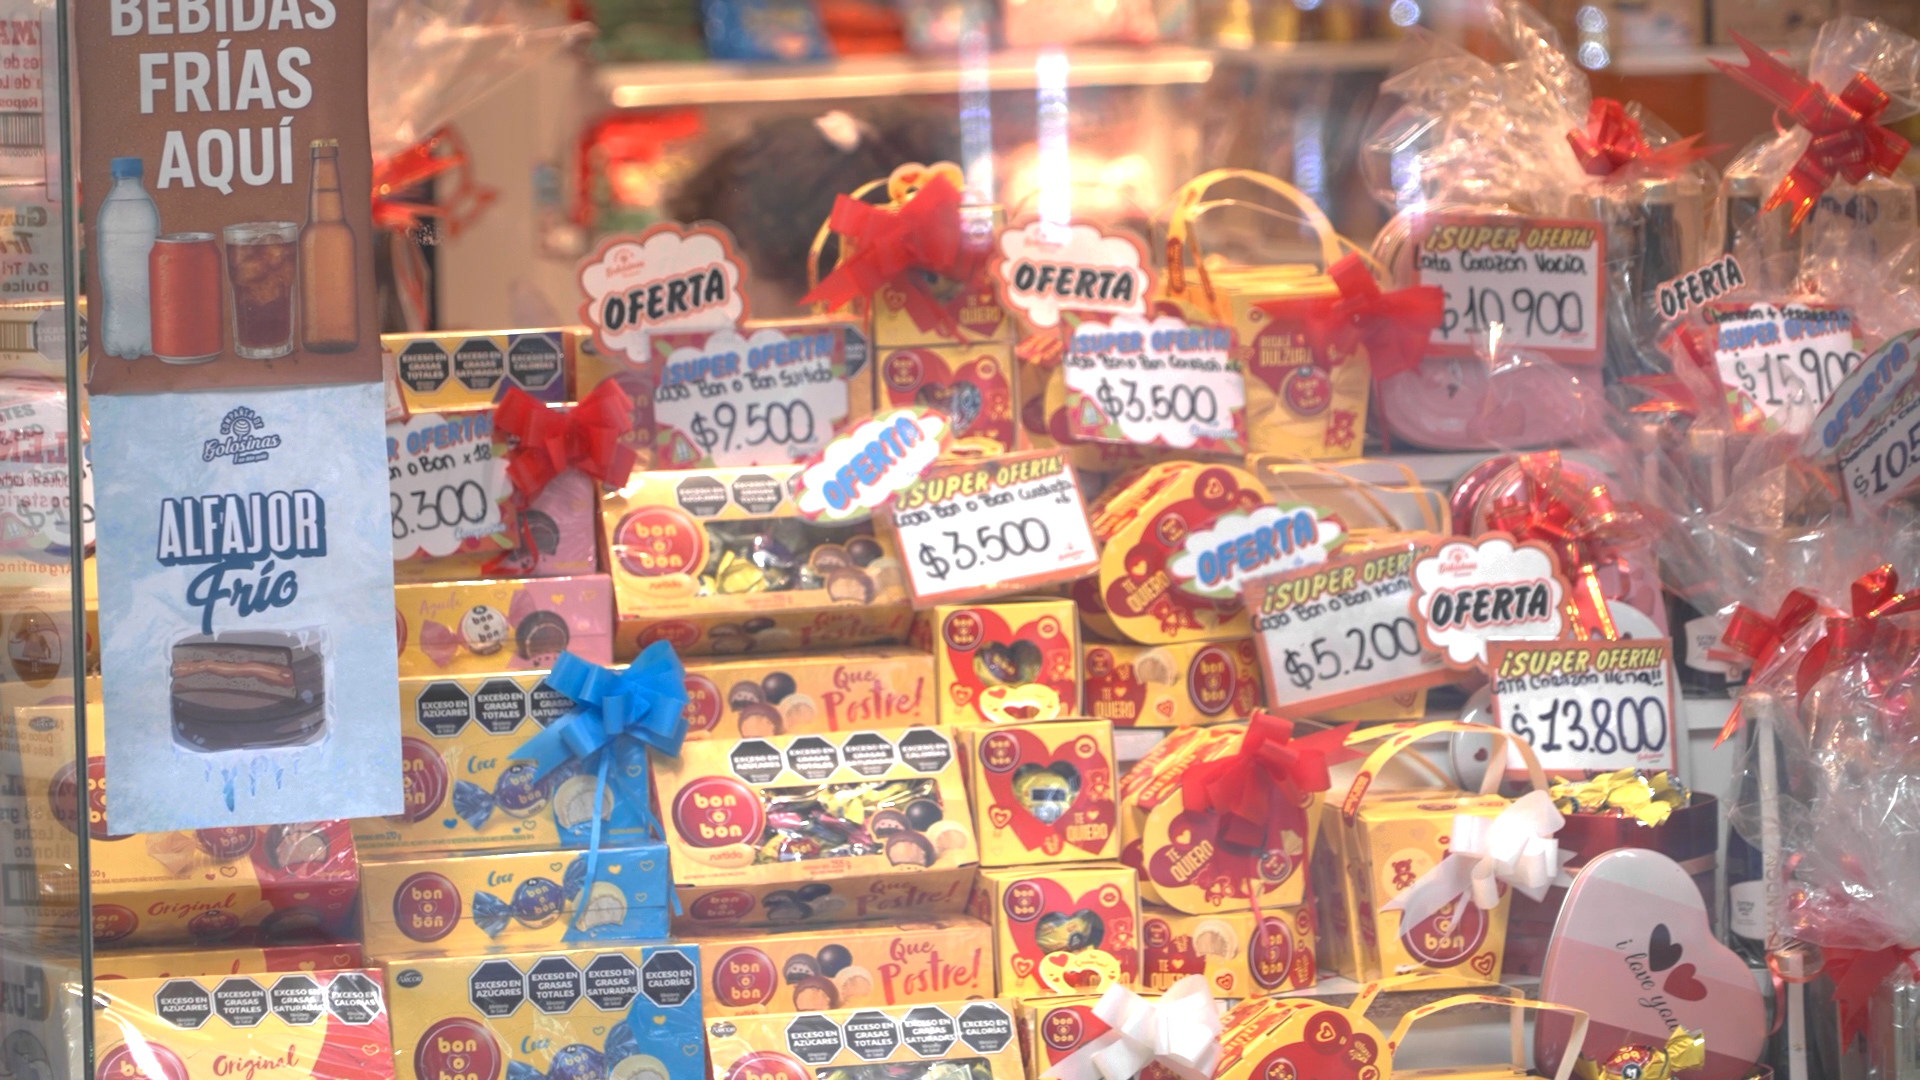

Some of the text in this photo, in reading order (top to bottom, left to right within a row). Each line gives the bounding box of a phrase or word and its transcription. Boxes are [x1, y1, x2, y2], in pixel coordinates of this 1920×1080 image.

[110, 0, 337, 36] BEBIDAS
[139, 40, 313, 114] FRÍAS
[157, 117, 294, 194] AQUÍ
[1426, 225, 1595, 250] ¡SUPER OFERTA!
[1014, 262, 1133, 301] OFERTA
[1660, 256, 1743, 316] OFERTA
[604, 268, 726, 331] OFERTA
[1438, 285, 1584, 339] $10.900
[1070, 329, 1232, 354] ¡SUPER OFERTA!
[662, 351, 739, 387] ¡SUPER
[747, 333, 835, 369] OFERTA!
[696, 379, 727, 399] Bon
[732, 380, 742, 393] o
[744, 373, 777, 390] Bon
[1096, 377, 1218, 424] $3.500
[1823, 341, 1909, 448] OFERTA
[690, 398, 815, 455] $9.500
[202, 434, 282, 462] Golosinas
[408, 453, 456, 476] o Bon
[822, 416, 925, 511] OFERTA
[996, 454, 1065, 488] OFERTA!
[966, 500, 979, 512] o
[157, 490, 327, 566] ALFAJOR
[635, 523, 677, 538] bon
[919, 517, 1051, 581] $3.500
[1196, 510, 1319, 588] OFERTA
[640, 553, 683, 568] bon
[1262, 565, 1356, 614] ¡SUPER
[187, 561, 298, 635] Frío
[1432, 583, 1549, 627] OFERTA
[1283, 616, 1422, 690] $5.200
[1200, 661, 1226, 674] bon
[1500, 648, 1663, 678] ¡SUPER OFERTA!
[833, 665, 879, 692] Que
[477, 692, 524, 702] EXCESO EN
[1201, 688, 1226, 702] bon
[421, 701, 468, 711] EXCESO EN
[484, 701, 518, 711] GRASAS
[821, 677, 925, 732] Postre!
[1093, 700, 1136, 719] QUIERO
[482, 710, 521, 720] TOTALES
[1511, 696, 1668, 756] $13.800
[467, 755, 498, 774] Coco
[518, 791, 542, 804] bon
[694, 793, 736, 808] bon
[700, 822, 742, 839] bon
[1066, 823, 1108, 842] QUIERO
[221, 832, 246, 847] bon
[1165, 847, 1182, 862] TE
[1170, 839, 1215, 883] QUIERO
[487, 871, 514, 887] Coco
[411, 888, 442, 900] bon
[526, 885, 549, 898] bon
[147, 892, 237, 918] Original
[534, 902, 556, 916] bon
[412, 914, 443, 928] bon
[1425, 933, 1464, 950] bon
[1615, 938, 1634, 951] i
[890, 938, 935, 965] Que
[729, 961, 760, 974] bon
[1158, 959, 1169, 971] TE
[1262, 962, 1283, 975] bon
[1624, 950, 1655, 991] love
[531, 971, 579, 983] EXCESO EN
[588, 968, 635, 979] EXCESO EN
[645, 969, 693, 980] EXCESO EN
[877, 948, 982, 1006] Postre!
[475, 979, 521, 990] EXCESO EN
[538, 980, 573, 990] GRASAS
[594, 977, 630, 987] GRASAS
[648, 976, 690, 988] CALORÍAS
[217, 990, 264, 999] EXCESO EN
[273, 988, 307, 997] EXCESO
[331, 992, 365, 1000] EXCESO
[475, 987, 522, 998] AZÚCARES
[536, 990, 575, 999] TOTALES
[587, 986, 638, 996] SATURADAS
[731, 986, 761, 1000] bon
[161, 997, 207, 1007] EXCESO EN
[162, 1003, 209, 1013] AZÚCARES
[224, 998, 260, 1007] GRASAS
[280, 996, 316, 1005] GRASAS
[222, 1006, 262, 1014] TOTALES
[1638, 992, 1679, 1032] you
[847, 1022, 894, 1032] EXCESO EN
[937, 1018, 951, 1026] EN
[962, 1018, 1009, 1029] EXCESO EN
[1052, 1016, 1074, 1026] bon
[791, 1030, 838, 1040] EXCESO EN
[854, 1030, 889, 1039] GRASAS
[965, 1026, 1008, 1036] CALORÍAS
[1053, 1033, 1075, 1043] bon
[437, 1037, 477, 1053] bon
[521, 1036, 551, 1054] Coco
[793, 1037, 839, 1047] AZÚCARES
[854, 1038, 893, 1047] TOTALES
[213, 1044, 299, 1077] Original
[564, 1052, 588, 1067] bon
